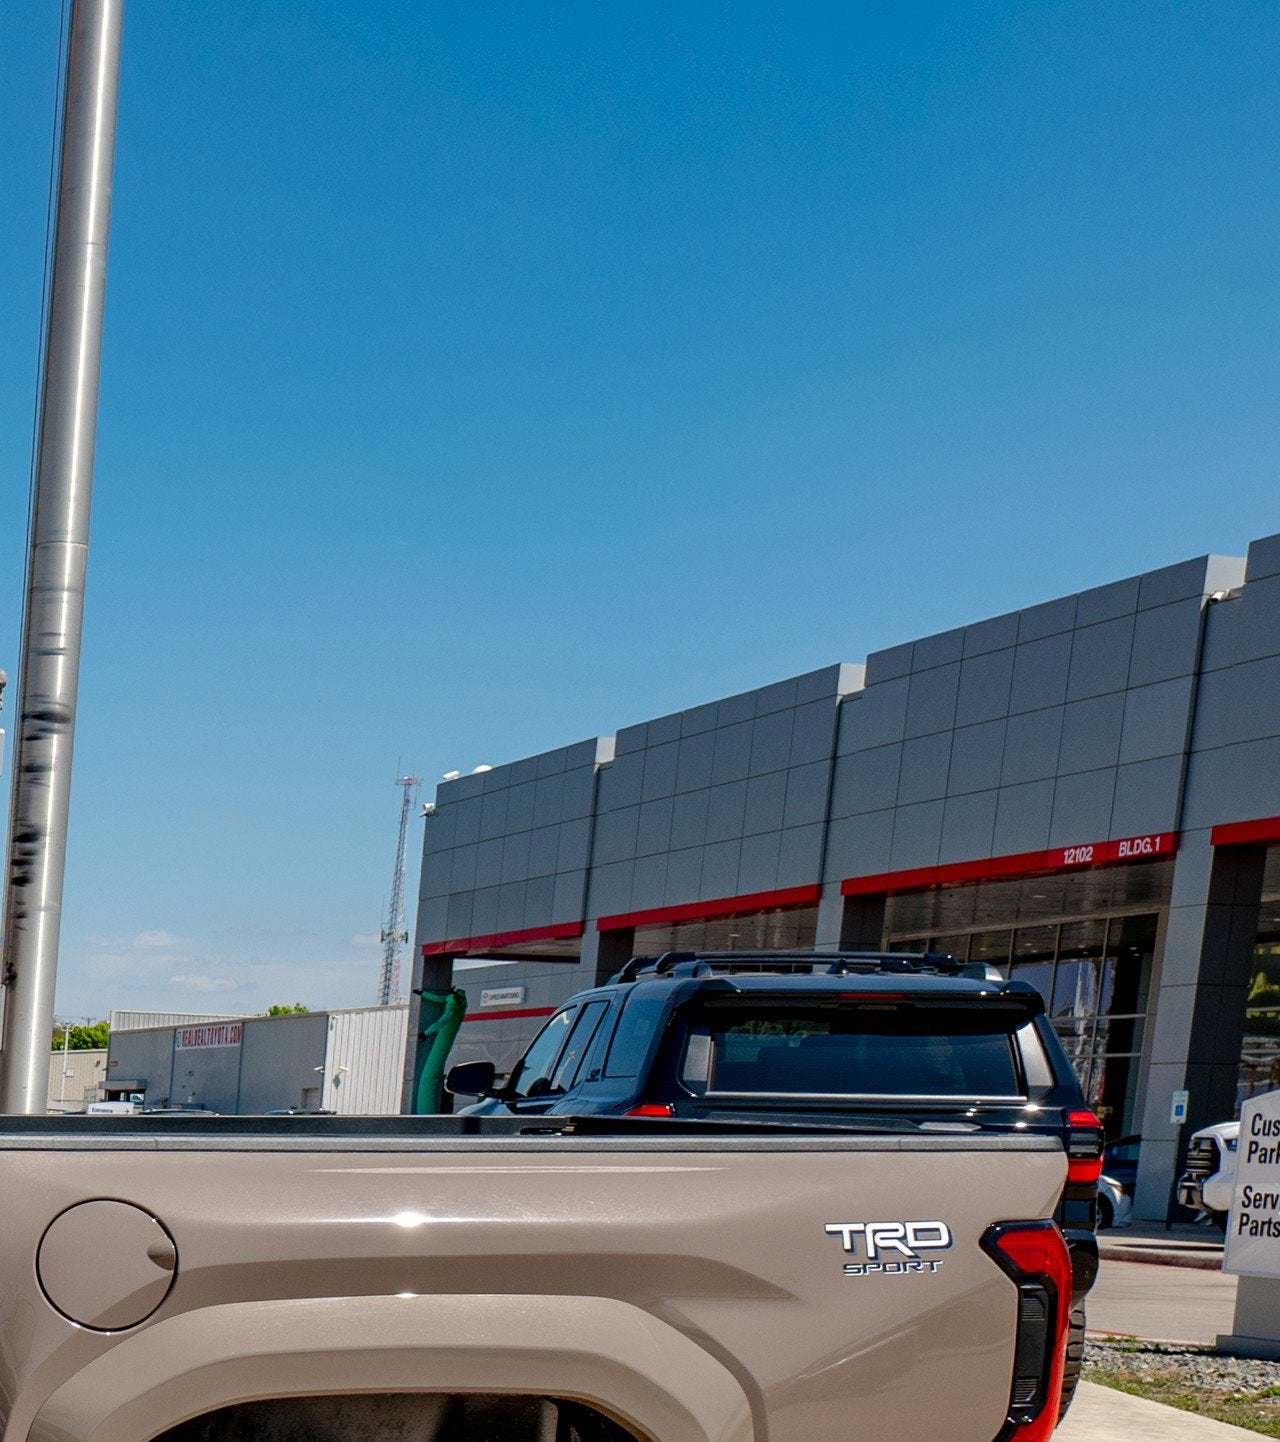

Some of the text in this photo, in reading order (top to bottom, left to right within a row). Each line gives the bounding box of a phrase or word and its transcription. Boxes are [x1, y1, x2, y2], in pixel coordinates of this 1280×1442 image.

[1063, 846, 1094, 865] 12102
[1241, 1185, 1280, 1210] Serv
[824, 1220, 954, 1260] TRD
[843, 1260, 943, 1276] SPORT
